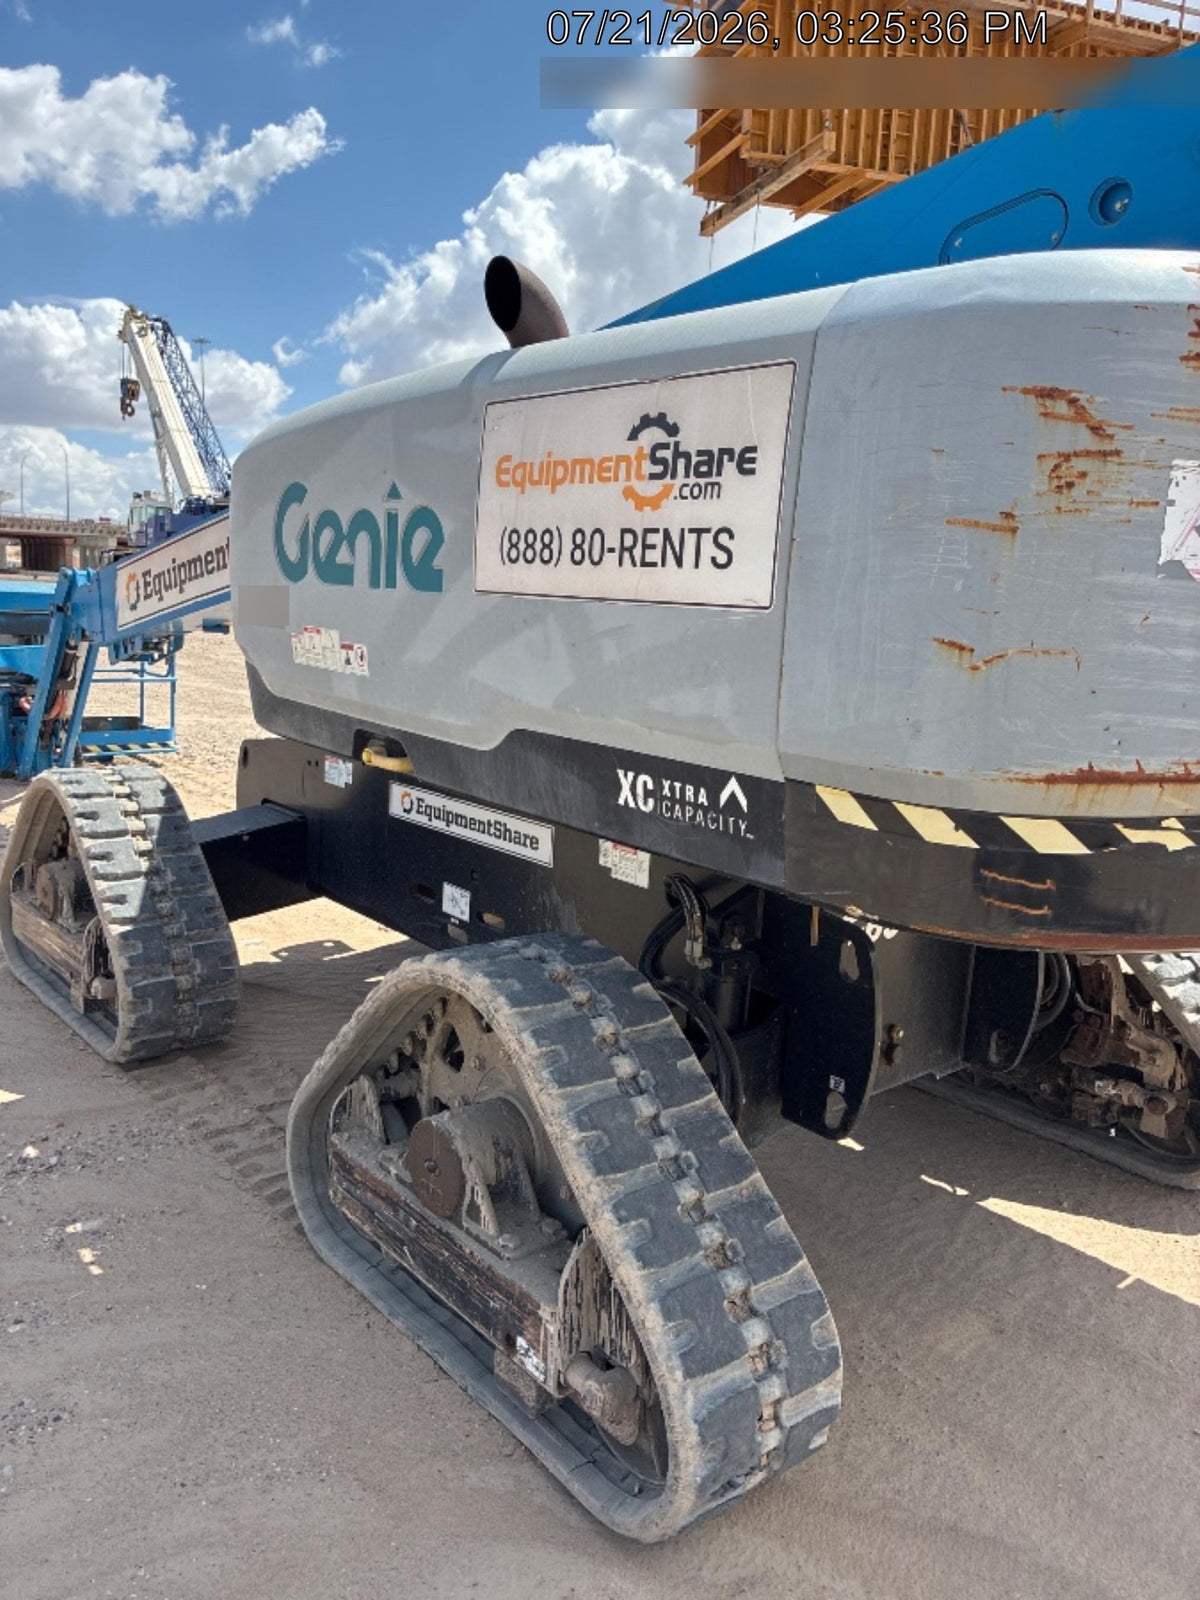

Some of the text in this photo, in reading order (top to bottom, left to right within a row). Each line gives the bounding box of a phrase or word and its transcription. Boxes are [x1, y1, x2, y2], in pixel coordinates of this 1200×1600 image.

[495, 440, 758, 495] EquipmentShare
[673, 480, 722, 500] .com
[275, 480, 445, 593] Genie
[500, 525, 735, 570] (888) 80-RENTS
[616, 768, 655, 814] XC
[661, 778, 709, 807] XTRA
[415, 796, 540, 852] EquipmentShare
